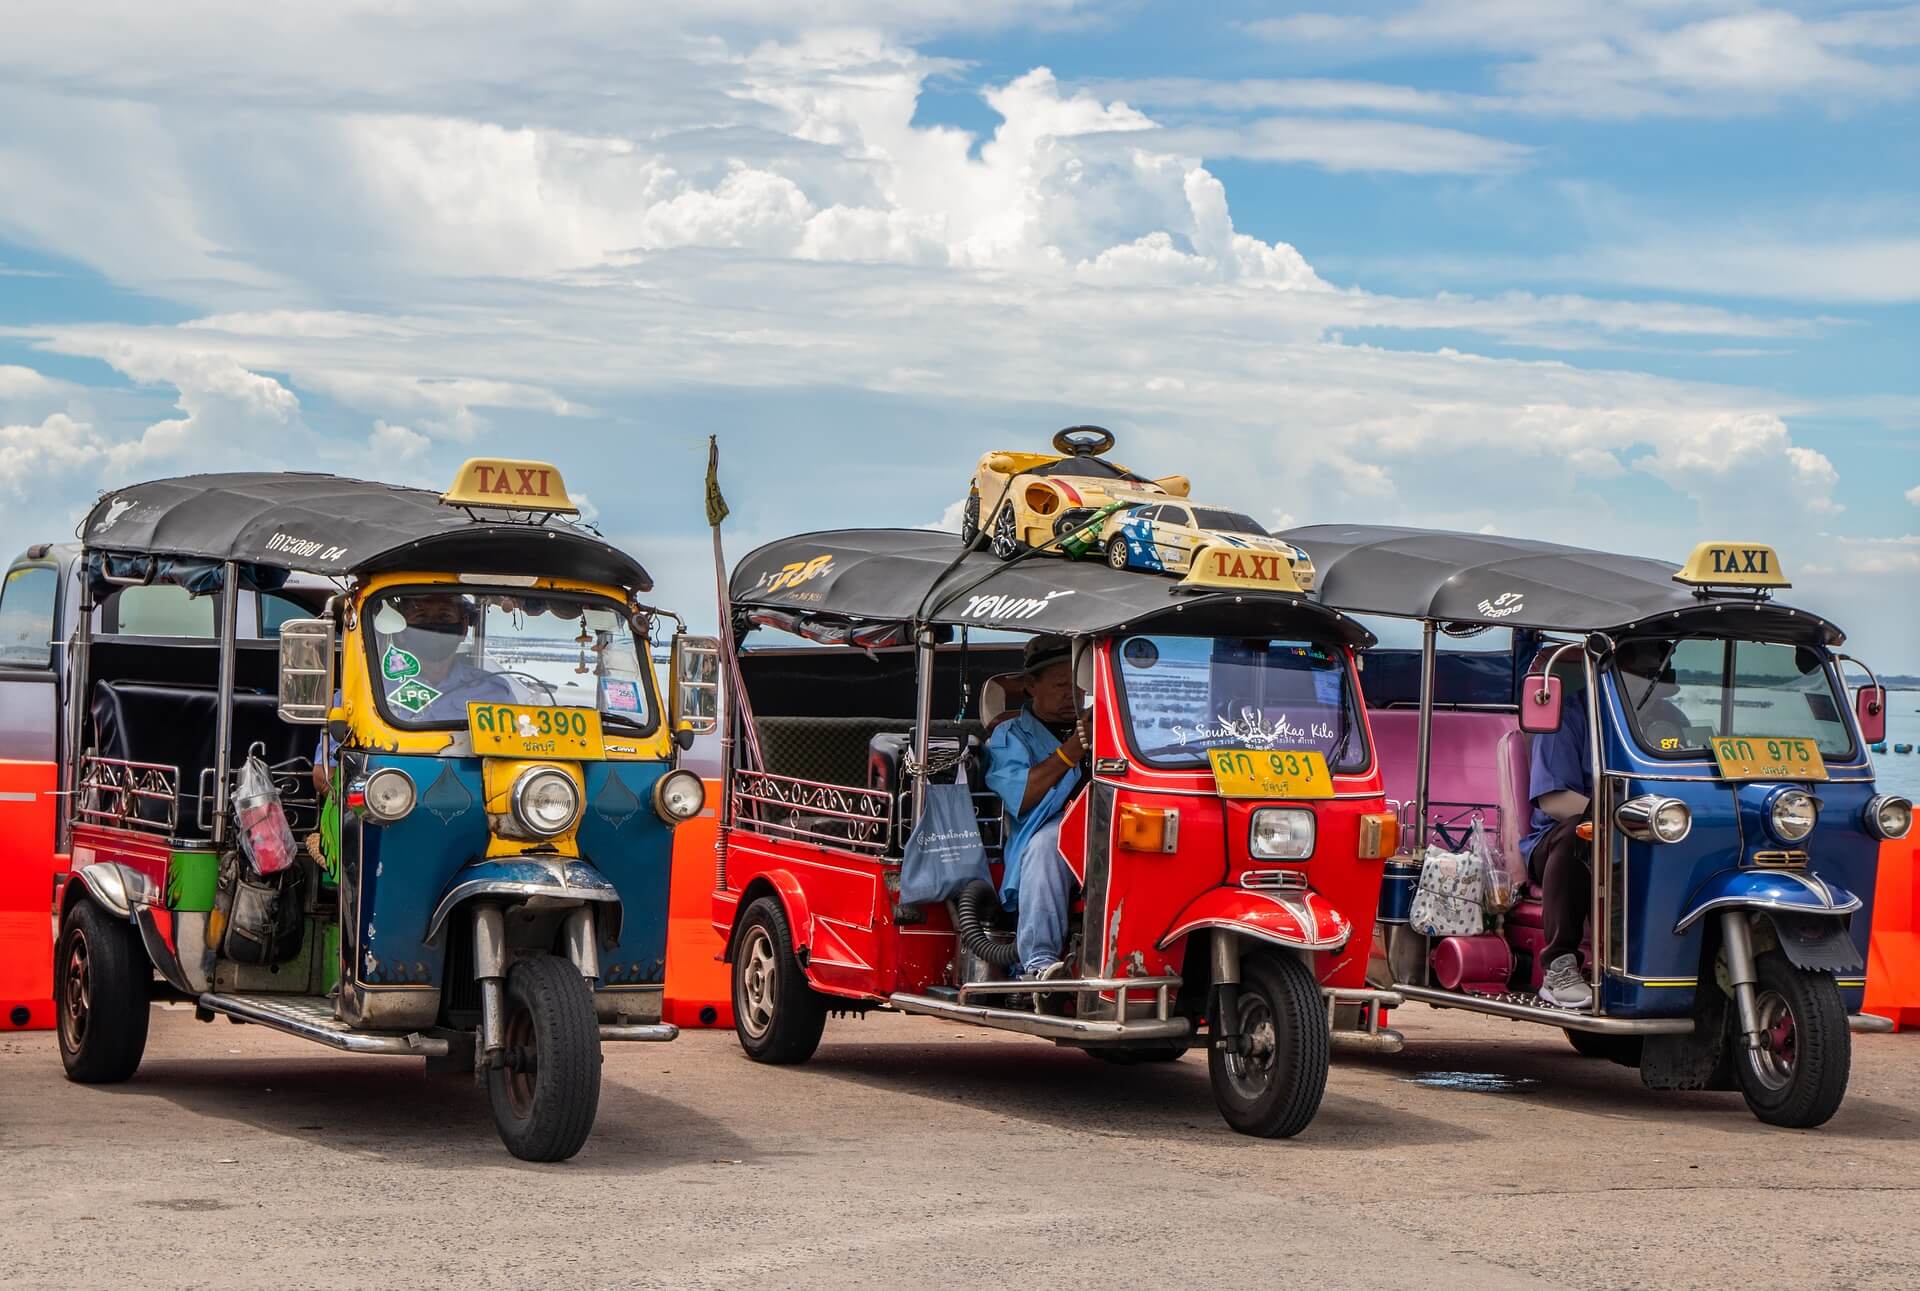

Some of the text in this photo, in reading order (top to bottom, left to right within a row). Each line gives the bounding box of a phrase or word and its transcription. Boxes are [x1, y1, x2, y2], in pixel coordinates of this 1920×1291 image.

[474, 465, 551, 497] TAXI
[320, 546, 348, 561] 04
[1709, 549, 1769, 574] TAXI
[1213, 551, 1281, 581] TAXI
[1494, 592, 1524, 607] 87
[397, 689, 431, 703] LPG
[475, 705, 588, 737] สก 390
[1284, 722, 1305, 738] Kao
[1311, 722, 1334, 739] Kilo
[523, 739, 556, 755] ชลบุรี
[1660, 738, 1679, 750] 87
[1718, 739, 1810, 762] สก 975
[1217, 751, 1314, 777] สก 931
